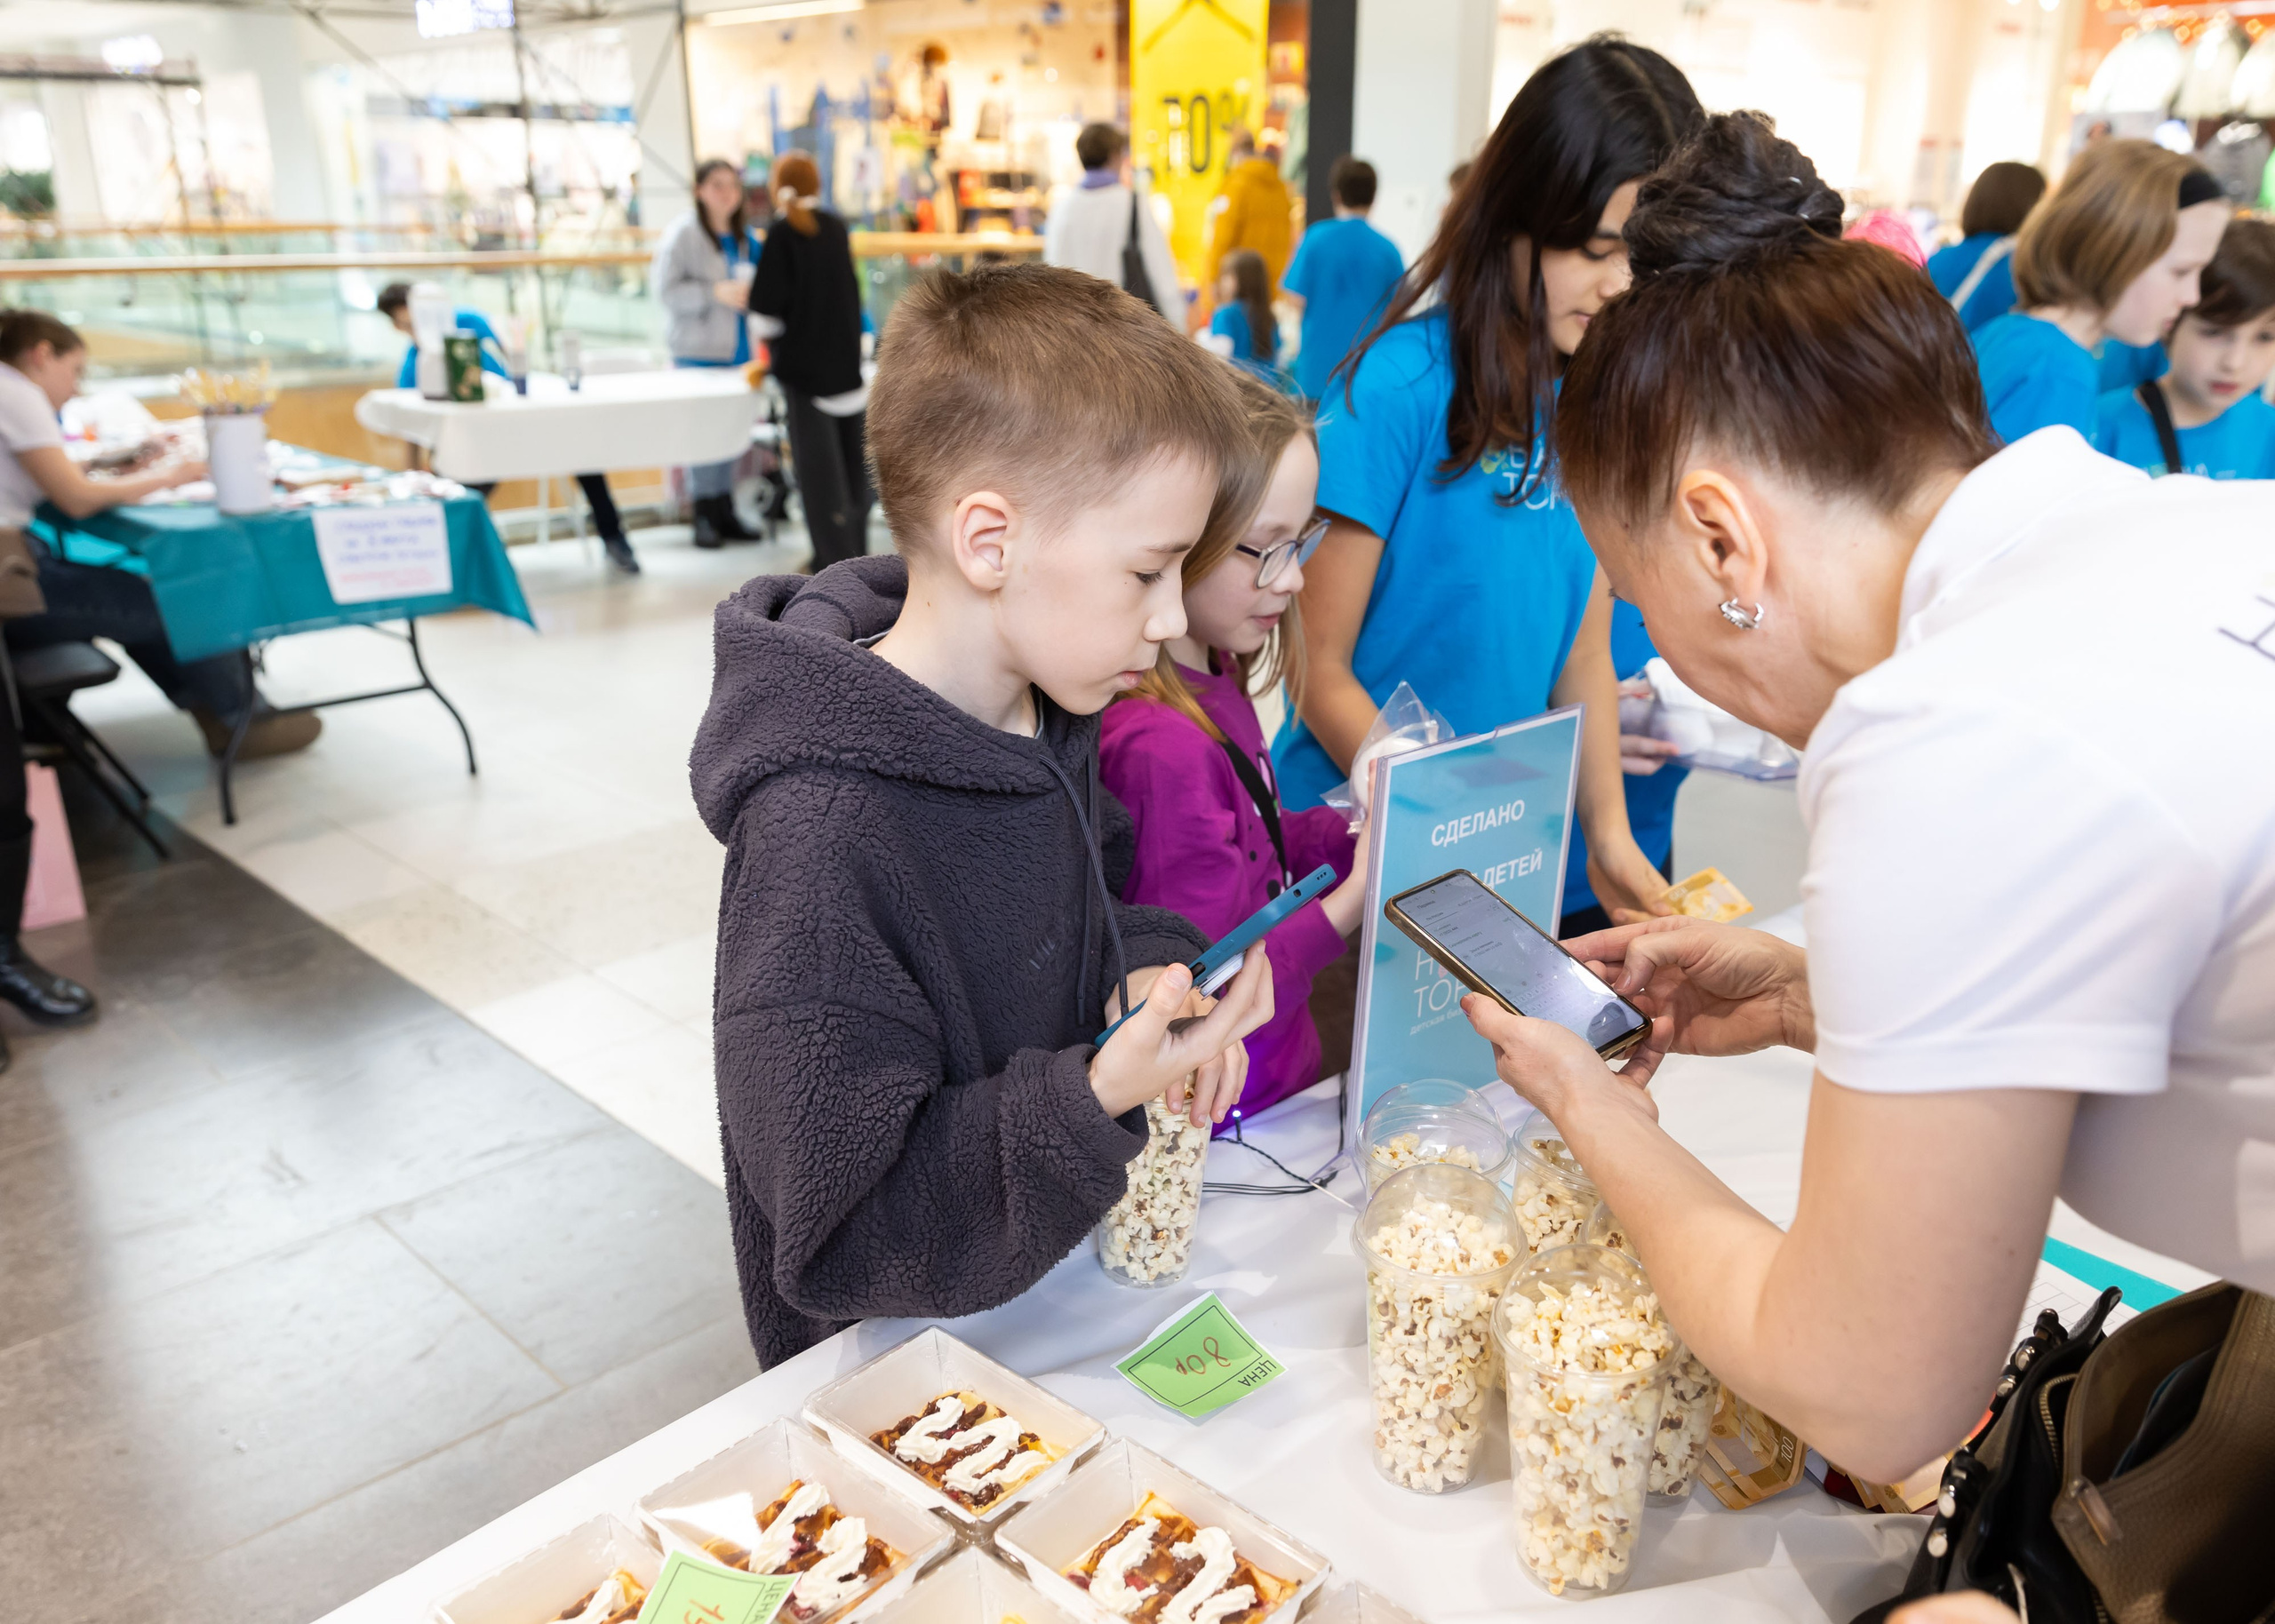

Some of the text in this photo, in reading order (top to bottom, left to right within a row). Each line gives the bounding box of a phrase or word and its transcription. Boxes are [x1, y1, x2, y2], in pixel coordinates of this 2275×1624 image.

[1431, 799, 1526, 848] СДЕЛАНО
[1482, 847, 1544, 890] ДЕТЕЙ
[1237, 1359, 1278, 1387] ЦЕНА
[1780, 1435, 1795, 1464] 100
[749, 1580, 787, 1624] ЦЕНА
